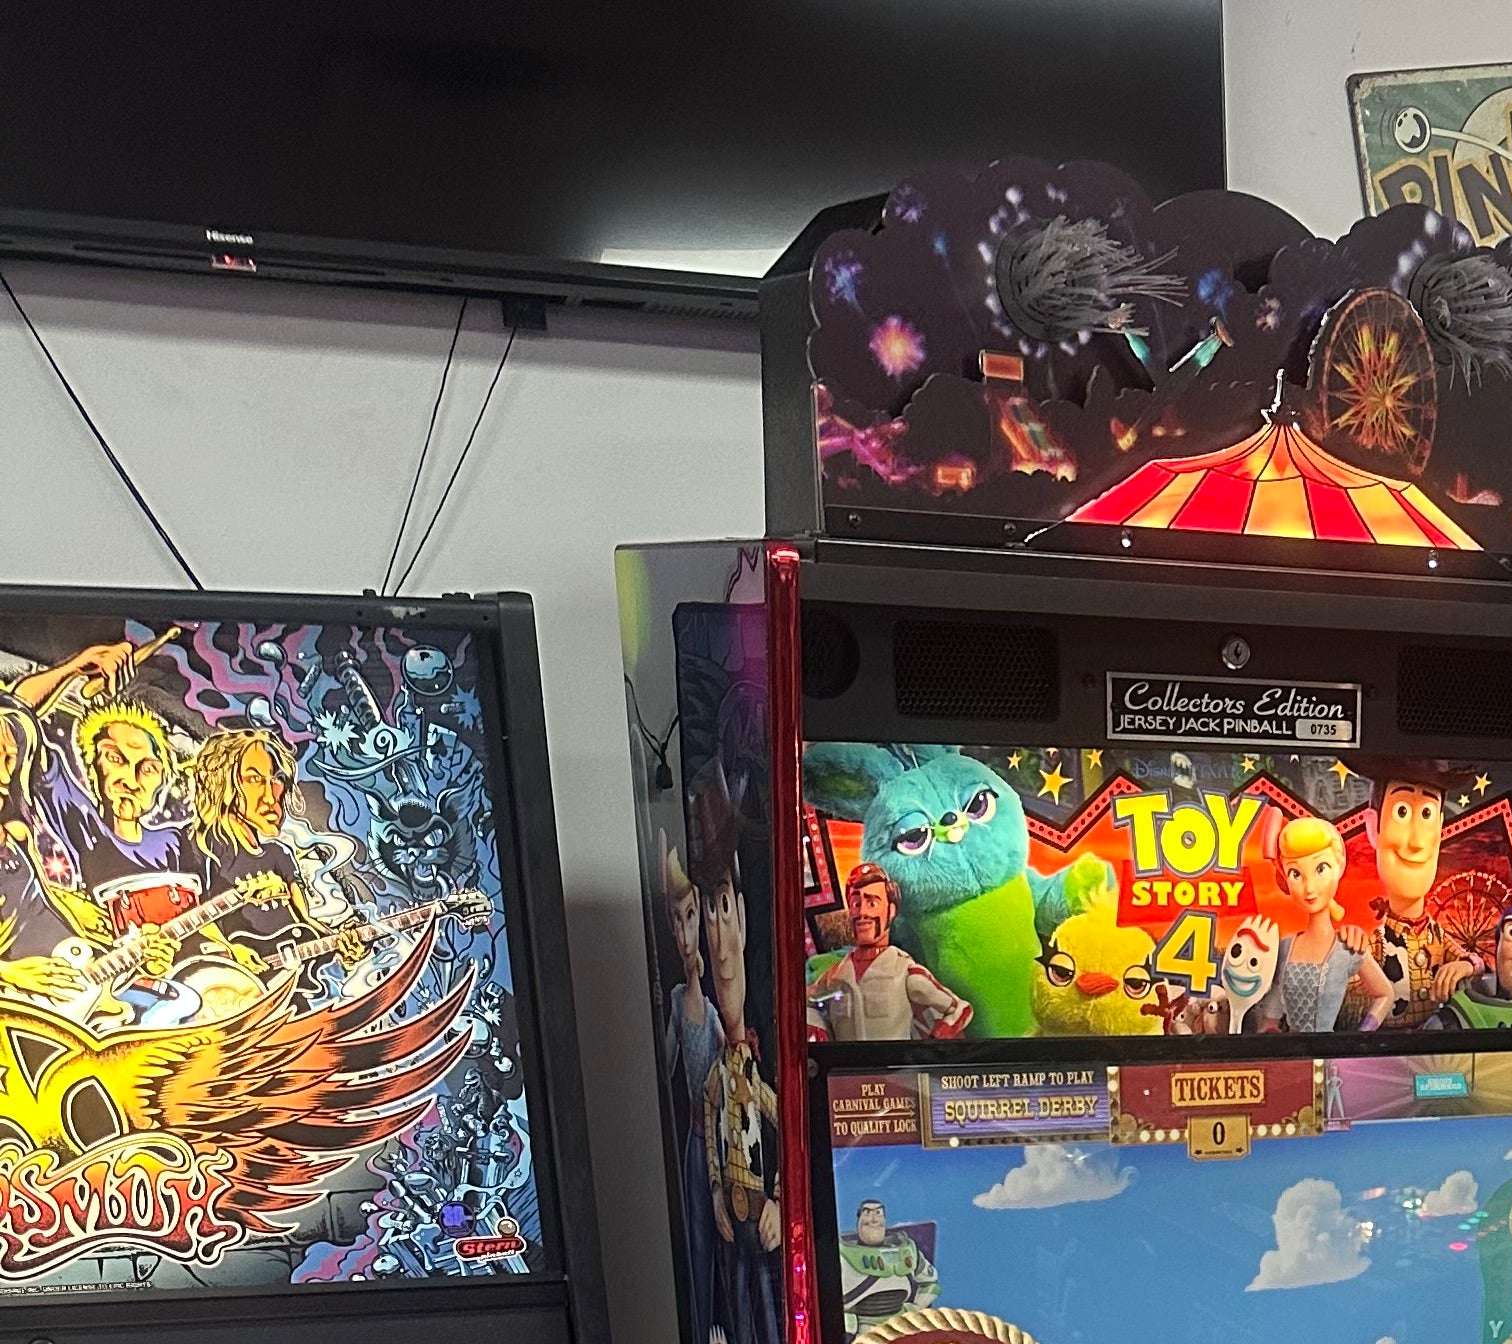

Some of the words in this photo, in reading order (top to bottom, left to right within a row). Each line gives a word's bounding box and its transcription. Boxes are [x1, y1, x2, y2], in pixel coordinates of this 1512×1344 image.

[1123, 681, 1246, 715] Collectors
[1253, 687, 1345, 719] Edition
[1115, 714, 1178, 733] JERSEY
[1177, 717, 1220, 734] JACK
[1223, 718, 1293, 736] PINBALL
[1310, 723, 1338, 736] 0735
[1115, 790, 1269, 874] TOY
[1130, 880, 1243, 908] STORY
[1156, 912, 1221, 994] 4
[861, 1083, 885, 1097] PLAY
[941, 1075, 979, 1090] SHOOT
[982, 1074, 1010, 1088] LEFT
[1013, 1073, 1046, 1087] RAMP
[1049, 1072, 1064, 1086] TO
[1067, 1070, 1095, 1085] PLAY
[1174, 1073, 1262, 1102] TICKETS
[832, 1098, 881, 1113] CARNIVAL
[883, 1097, 916, 1110] GAMES
[944, 1099, 1034, 1128] SQUIRREL
[1038, 1094, 1099, 1120] DERBY
[834, 1121, 849, 1136] TO
[850, 1119, 892, 1137] QUALIFY
[893, 1117, 918, 1133] LOCK
[1212, 1121, 1225, 1146] 0
[463, 1241, 521, 1255] Stern
